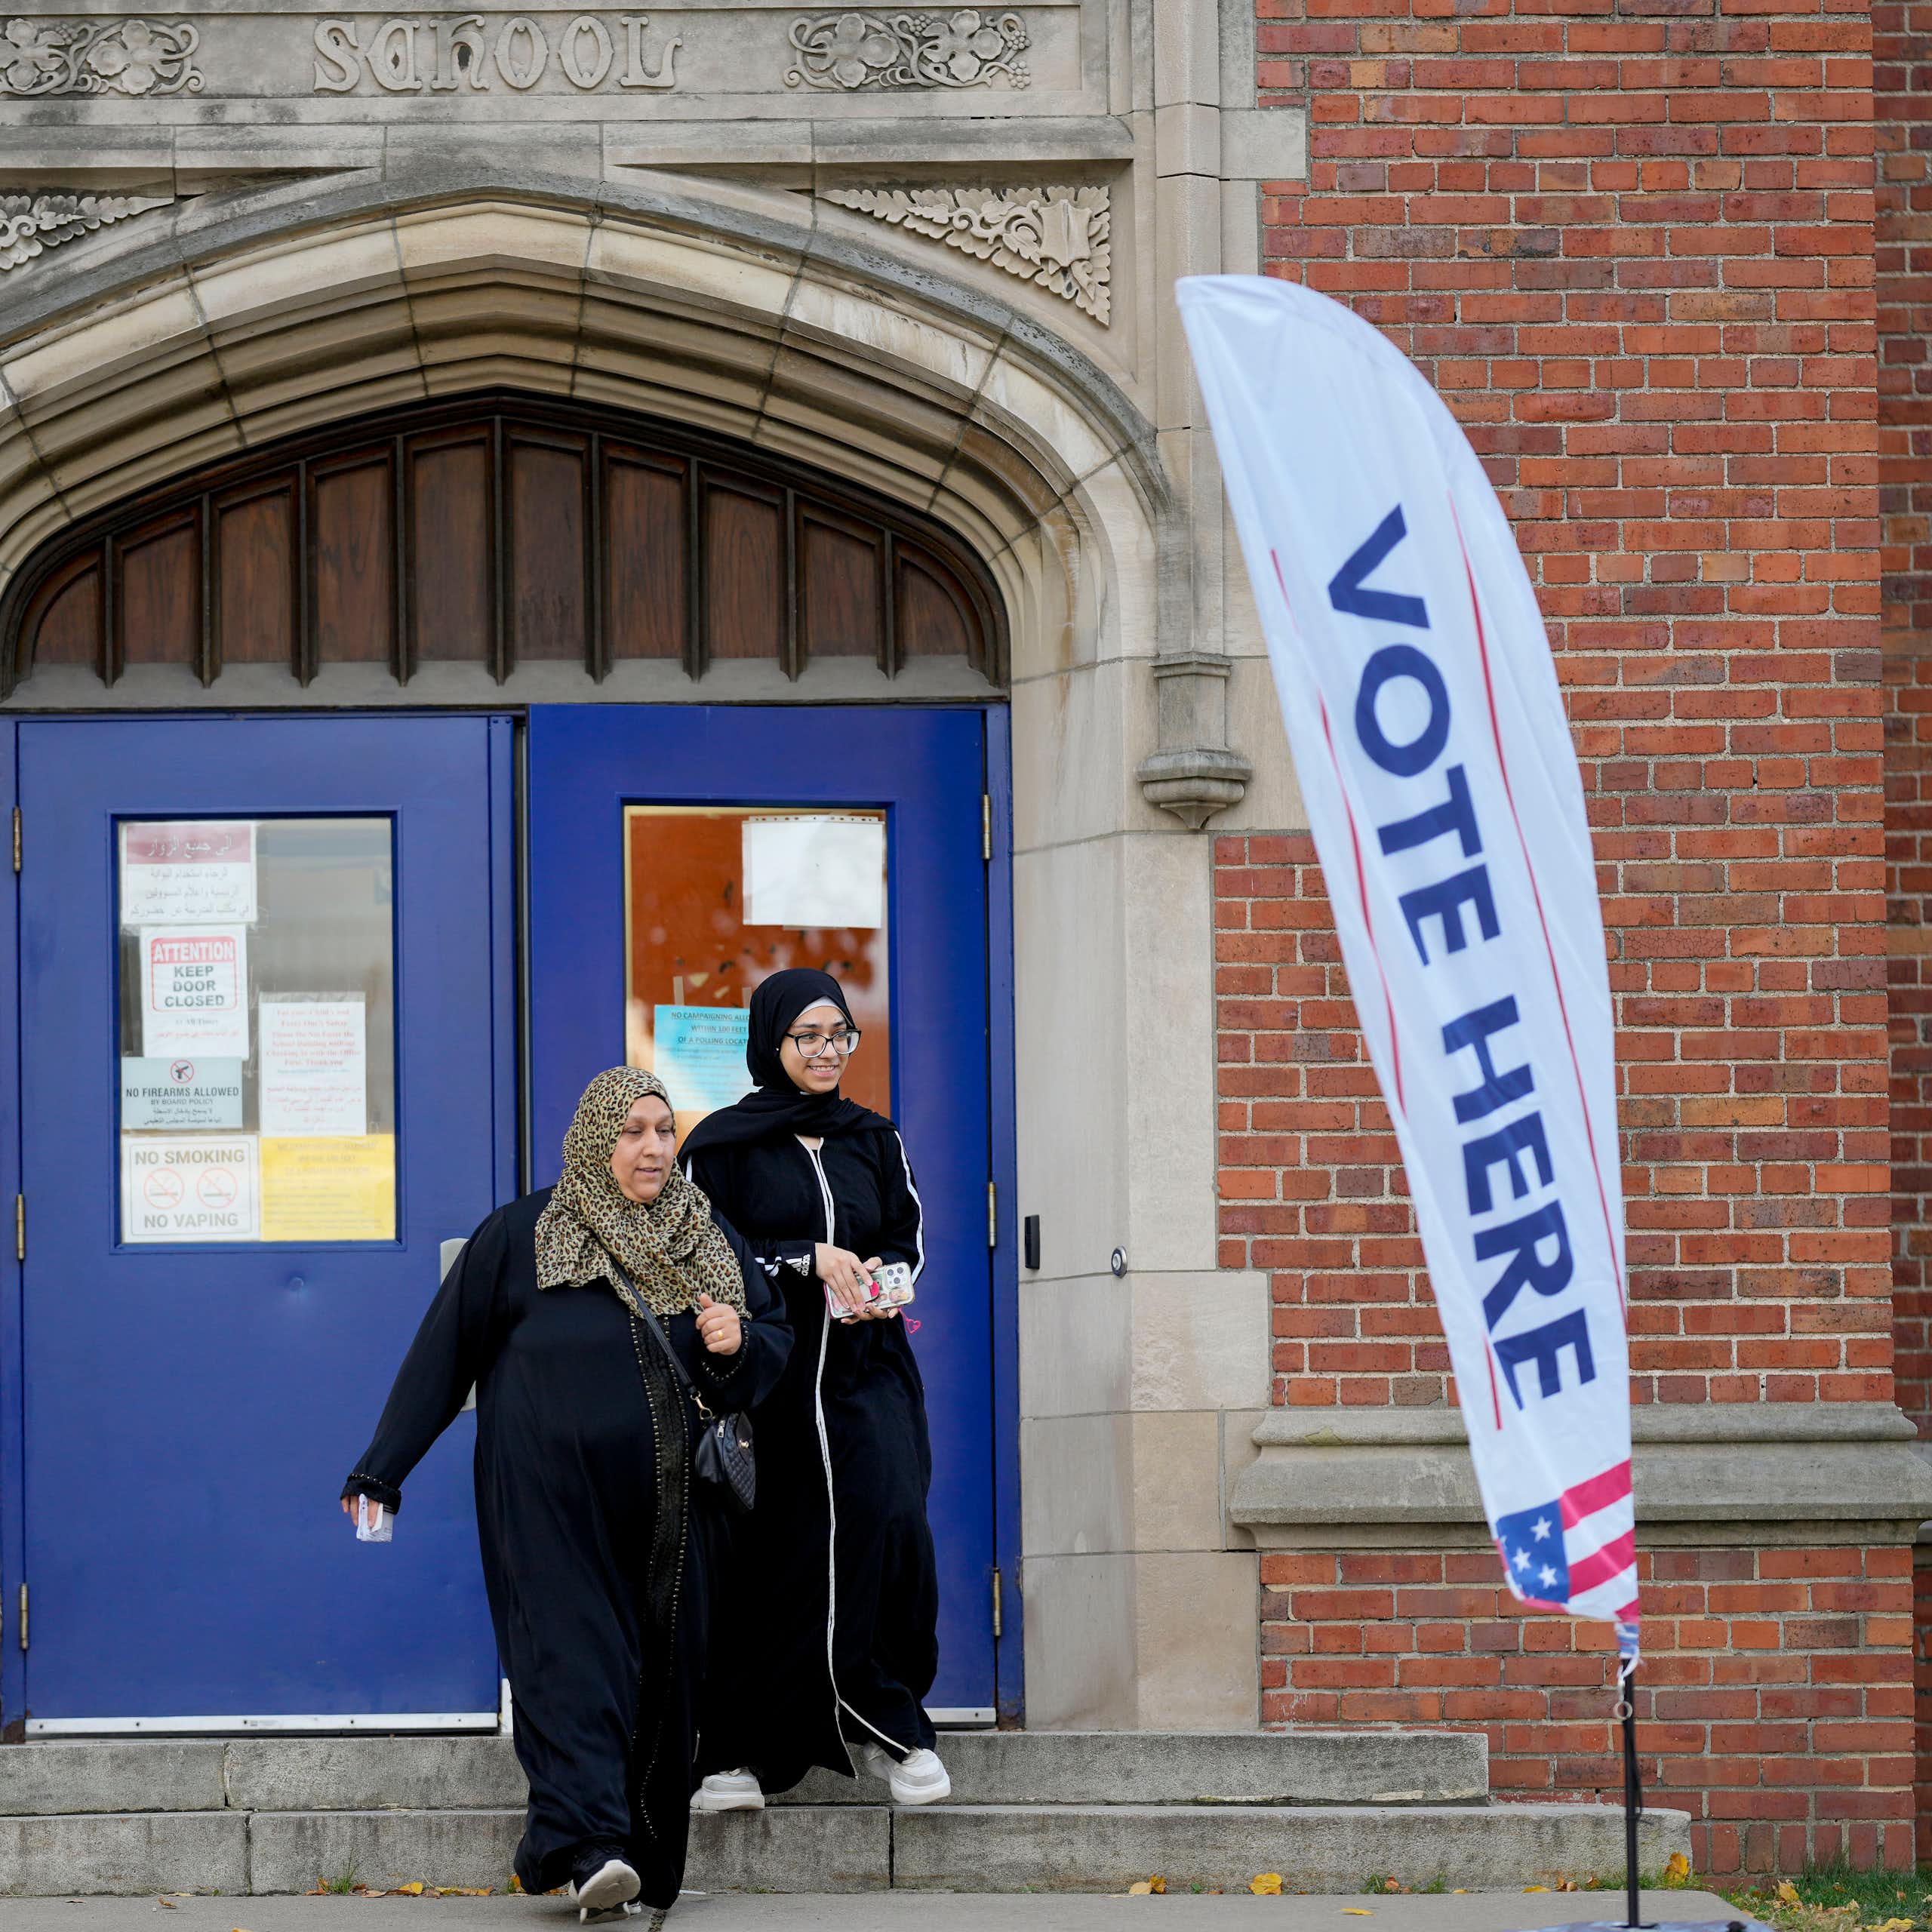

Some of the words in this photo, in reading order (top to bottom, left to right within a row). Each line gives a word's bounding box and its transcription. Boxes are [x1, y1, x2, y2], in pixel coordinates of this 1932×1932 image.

[313, 14, 683, 92] SCHOOL
[155, 941, 234, 961] ATTENTION
[1328, 503, 1502, 968] VOTE
[1441, 993, 1597, 1412] HERE
[174, 965, 214, 978] KEEP
[173, 980, 217, 992] DOOR
[165, 994, 225, 1008] CLOSED
[671, 1011, 682, 1020] NO
[683, 1011, 732, 1021] CAMPAIGNING
[691, 1024, 716, 1033] WITHIN
[696, 1037, 724, 1045] POLLING
[126, 1088, 140, 1097] NO
[143, 1087, 191, 1097] FIREARMS
[194, 1086, 239, 1097] ALLOWED
[135, 1150, 160, 1166] NO
[164, 1149, 245, 1164] SMOKING
[143, 1214, 168, 1229] NO
[174, 1212, 238, 1228] VAPING
[801, 1254, 811, 1276] adidas
